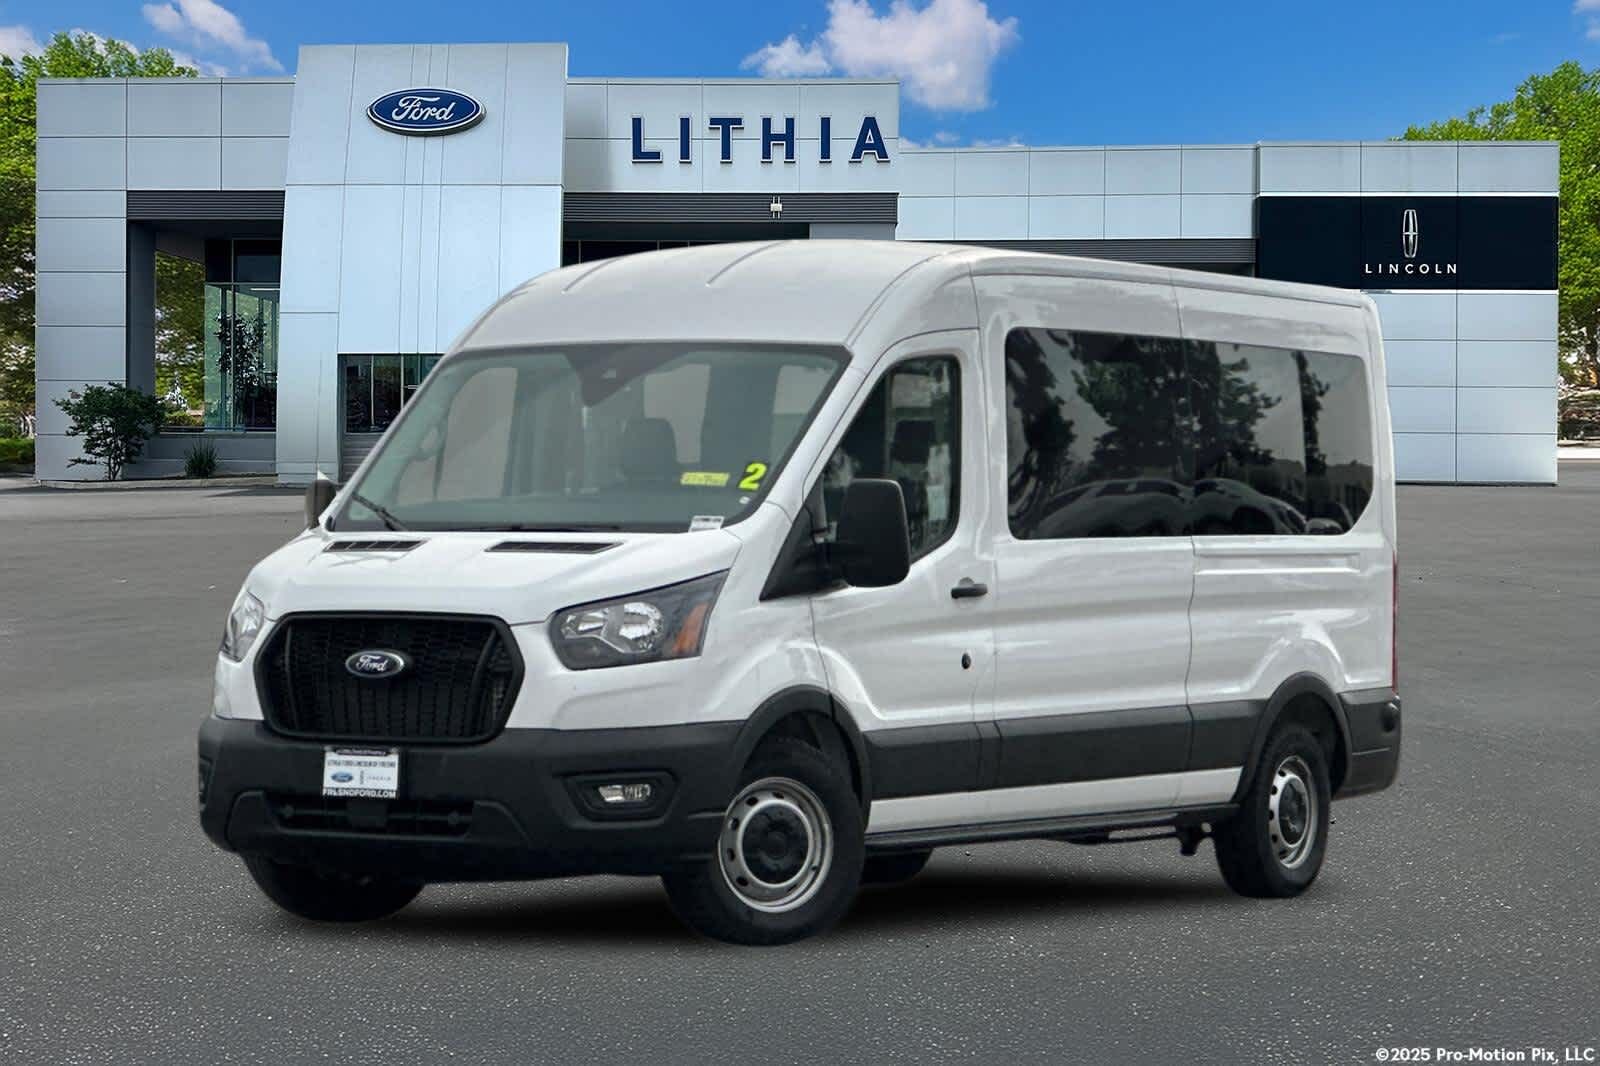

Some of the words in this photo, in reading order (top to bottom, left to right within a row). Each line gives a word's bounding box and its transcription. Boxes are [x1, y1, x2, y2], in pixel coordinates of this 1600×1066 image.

[391, 95, 457, 121] Ford
[631, 116, 891, 164] LITHIA
[1365, 263, 1457, 274] LINCOLN
[738, 462, 767, 490] 2
[355, 654, 389, 672] Ford
